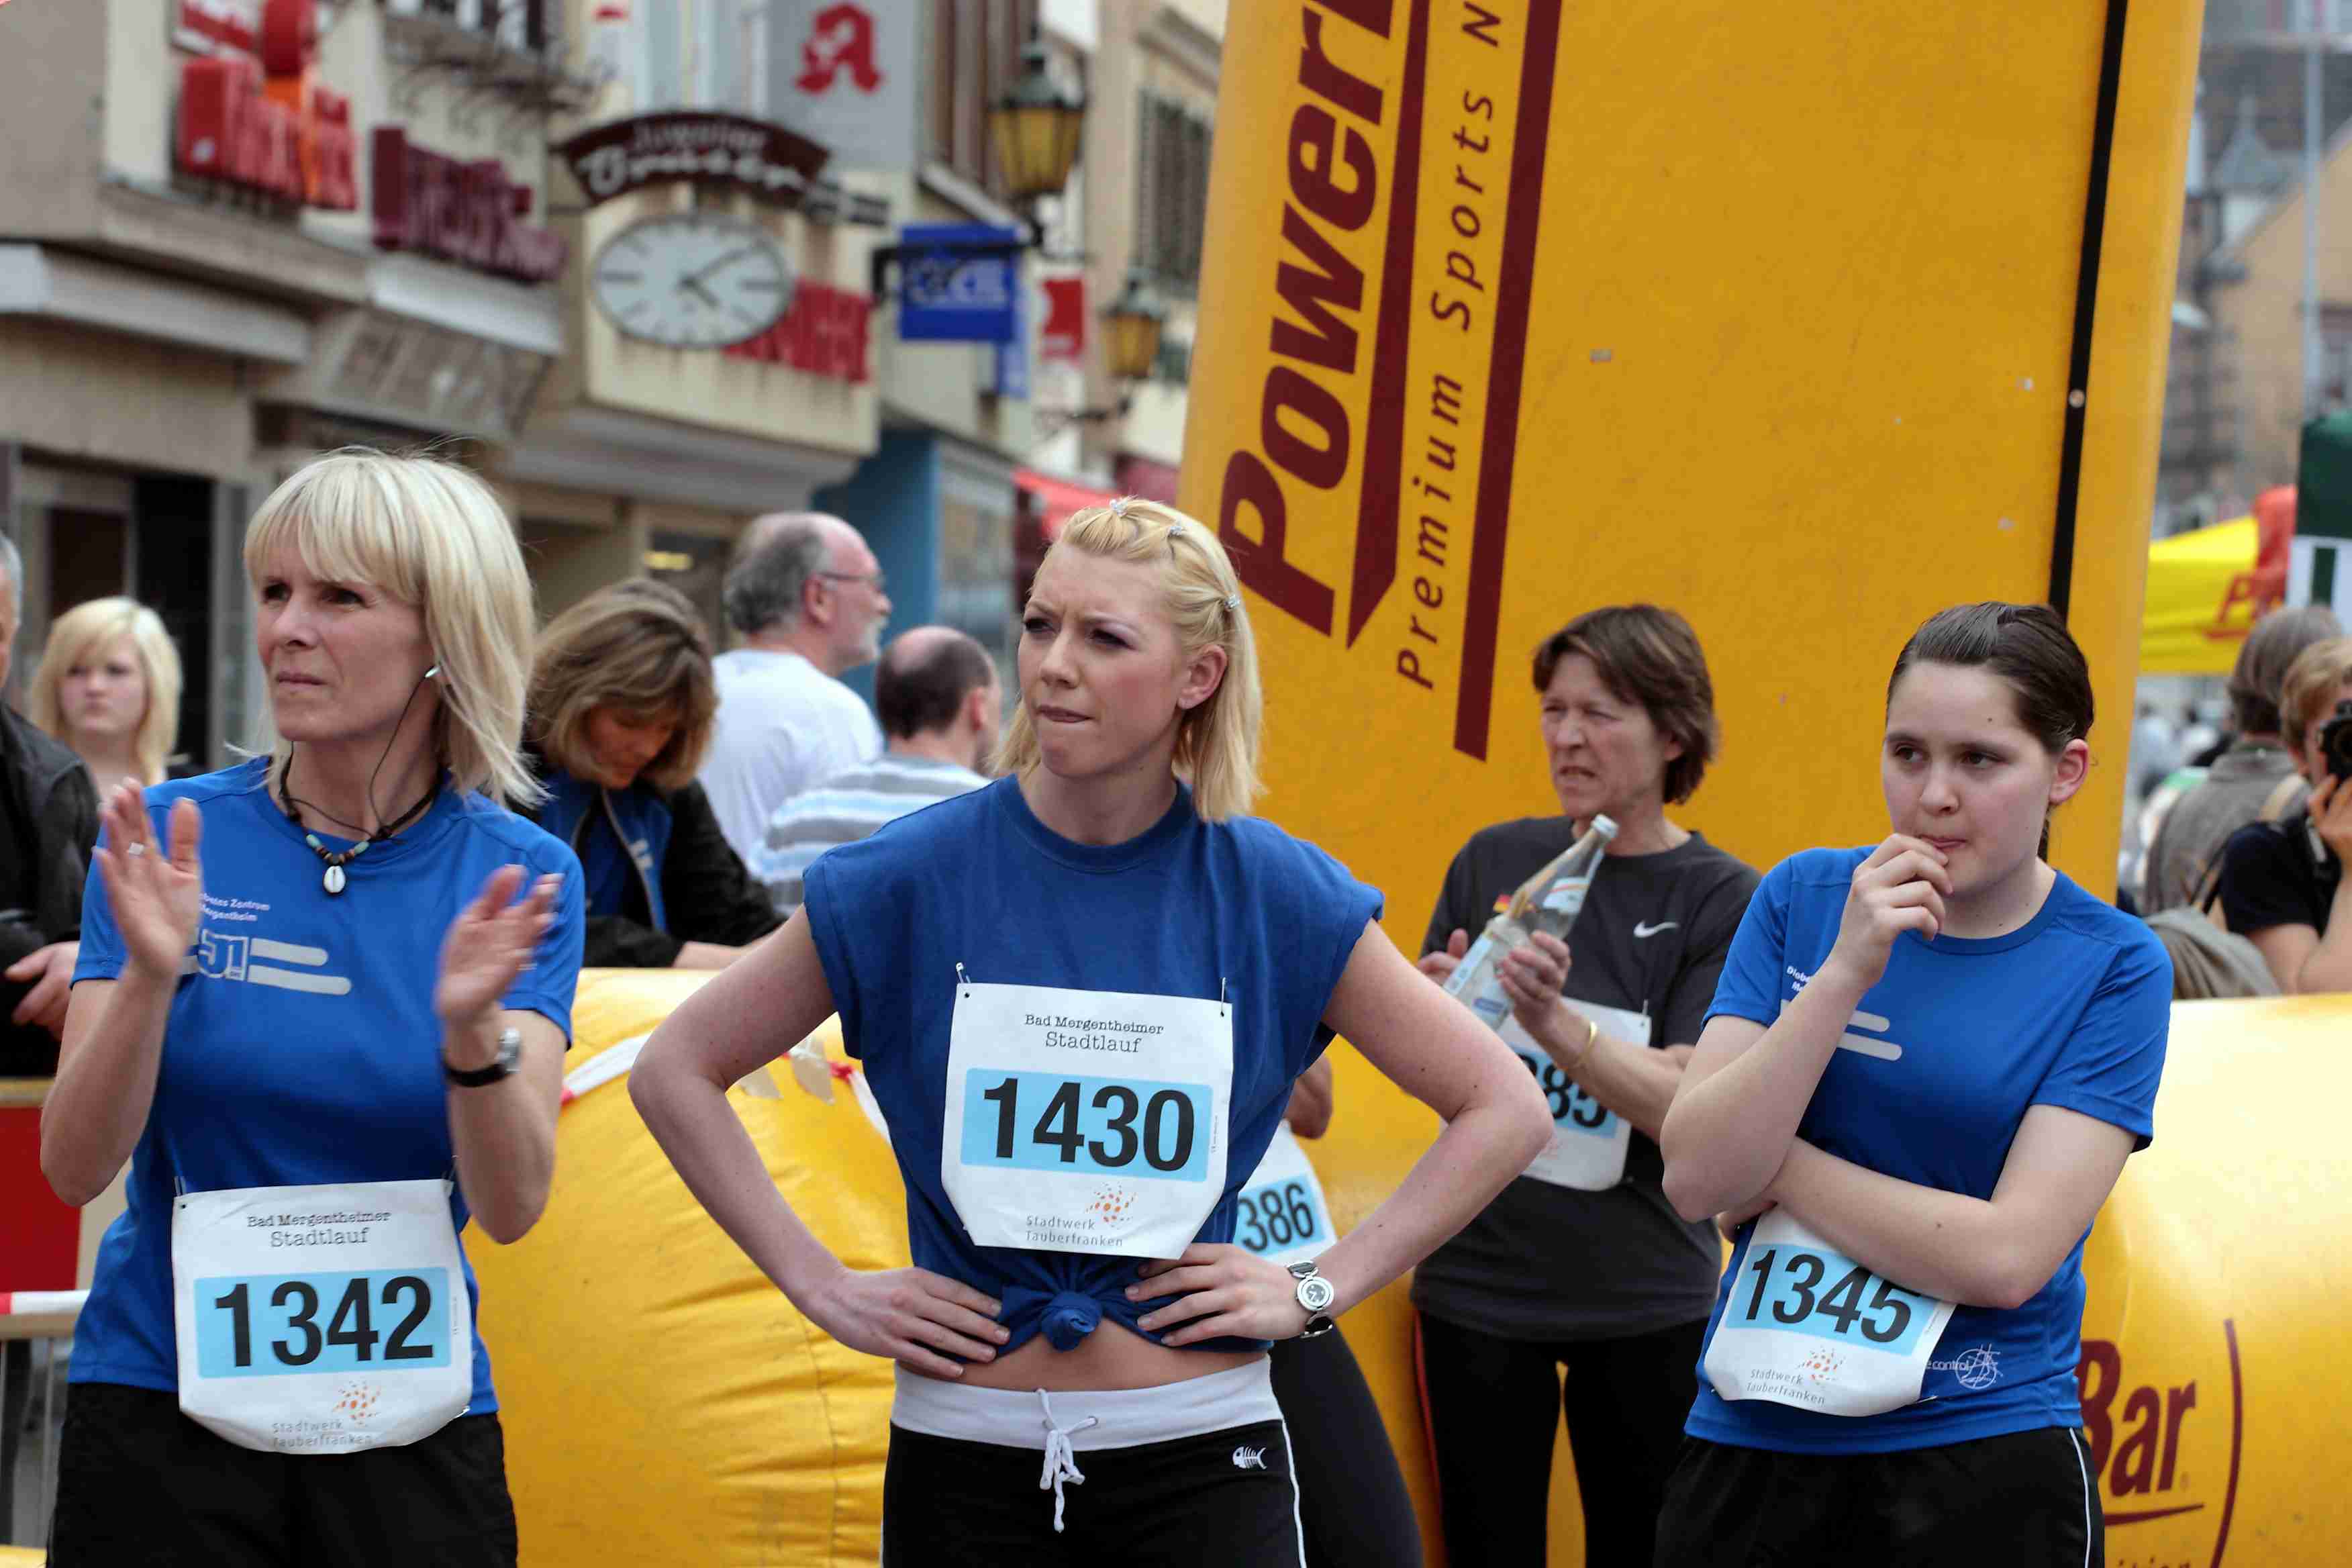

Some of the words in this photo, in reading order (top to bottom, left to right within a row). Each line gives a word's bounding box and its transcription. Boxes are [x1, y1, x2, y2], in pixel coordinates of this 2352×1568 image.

[1397, 372, 1463, 691] Premium
[1430, 90, 1494, 333] Sports
[1024, 1014, 1052, 1027] Bad
[1055, 1016, 1165, 1035] Mergentheimer
[1044, 1031, 1142, 1054] Stadtlauf
[983, 1077, 1195, 1173] 1430
[246, 1214, 275, 1228] Bad
[279, 1210, 392, 1228] Mergentheimer
[1026, 1215, 1095, 1230] Stadtwerk
[270, 1227, 371, 1248] Stadtlauf
[1026, 1232, 1123, 1247] Tauberfranken
[1745, 1248, 1921, 1343] 1345
[214, 1275, 435, 1367] 1342
[1750, 1368, 1804, 1385] Stadtwerk
[1745, 1382, 1826, 1406] Tauberfranken
[272, 1420, 344, 1434] Stadtwerk
[2074, 1338, 2196, 1498] Bar
